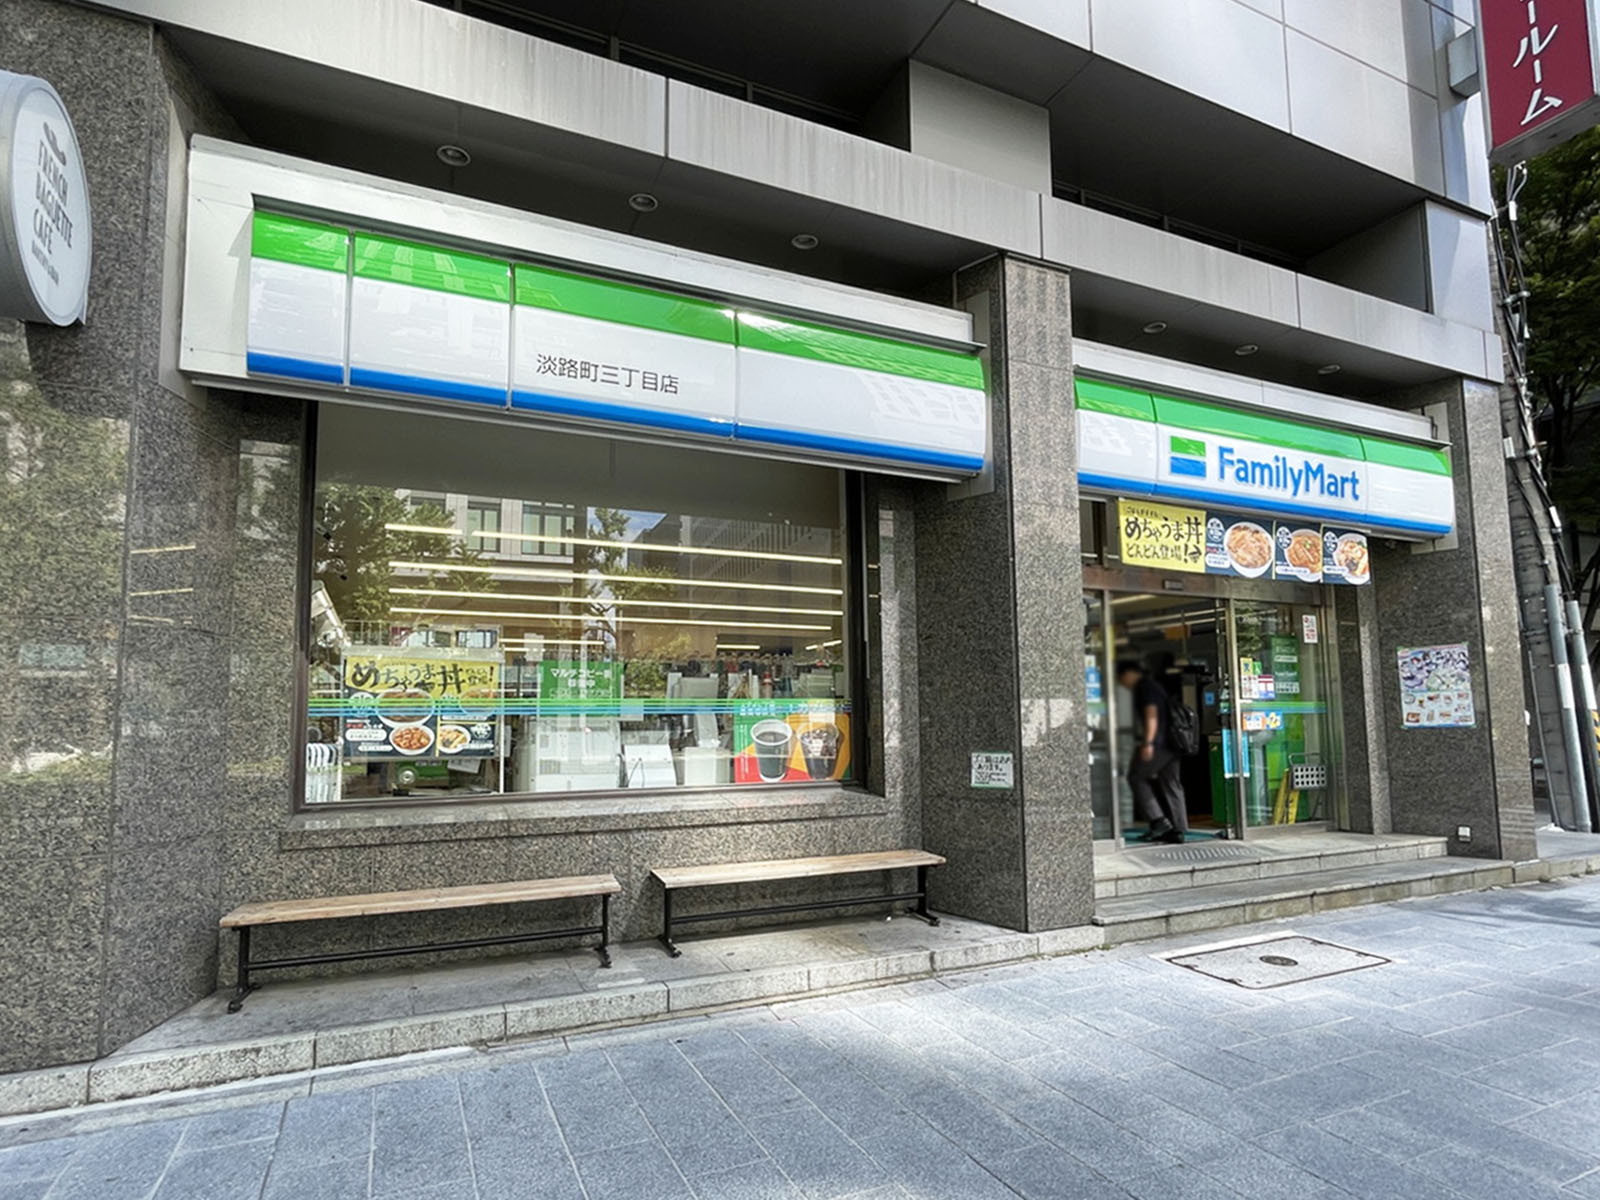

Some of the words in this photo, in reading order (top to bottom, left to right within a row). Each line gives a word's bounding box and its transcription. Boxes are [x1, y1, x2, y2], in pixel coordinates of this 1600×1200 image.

[1512, 0, 1563, 126] ールーム
[38, 139, 68, 206] FRENCH
[536, 353, 679, 394] 淡路町三丁目店
[1218, 446, 1360, 500] FamilyMart
[1125, 516, 1203, 544] めちゃうま丼
